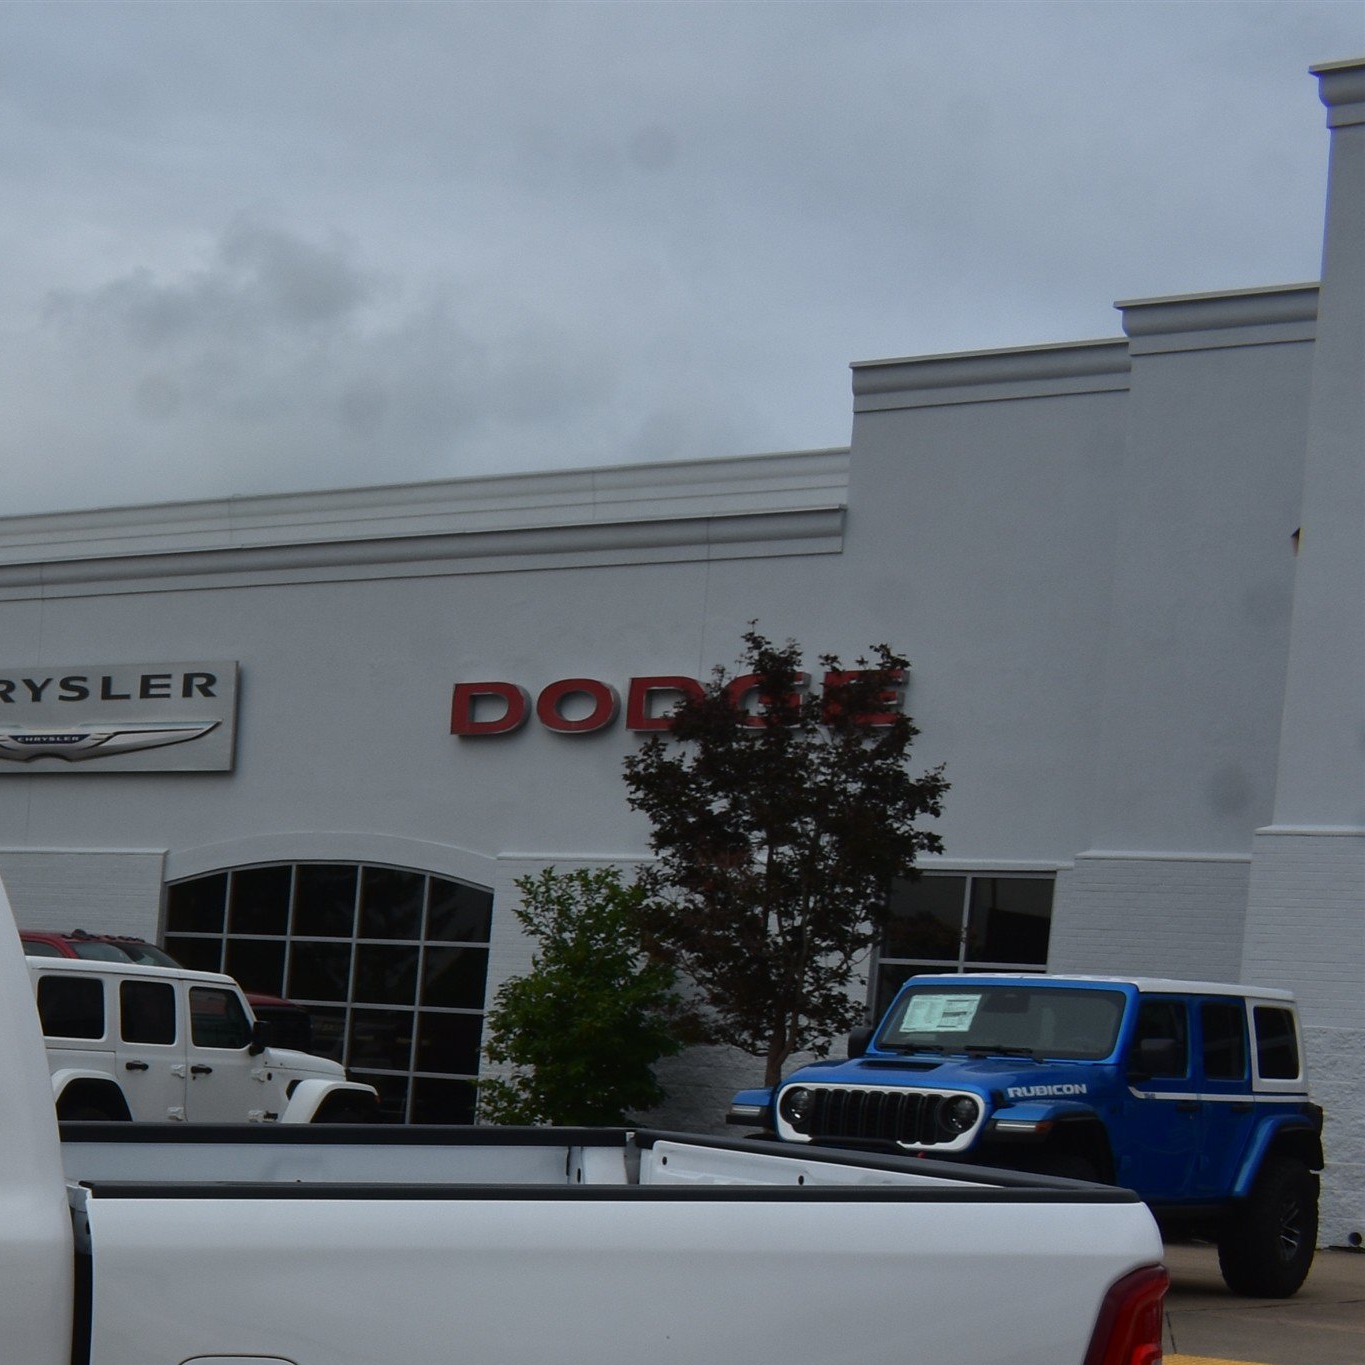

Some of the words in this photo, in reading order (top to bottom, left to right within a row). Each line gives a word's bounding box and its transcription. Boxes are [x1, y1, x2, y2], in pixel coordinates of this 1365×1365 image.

[449, 667, 910, 737] DODGE
[17, 735, 79, 743] CHRYSLER
[1006, 1083, 1088, 1099] RUBICON
